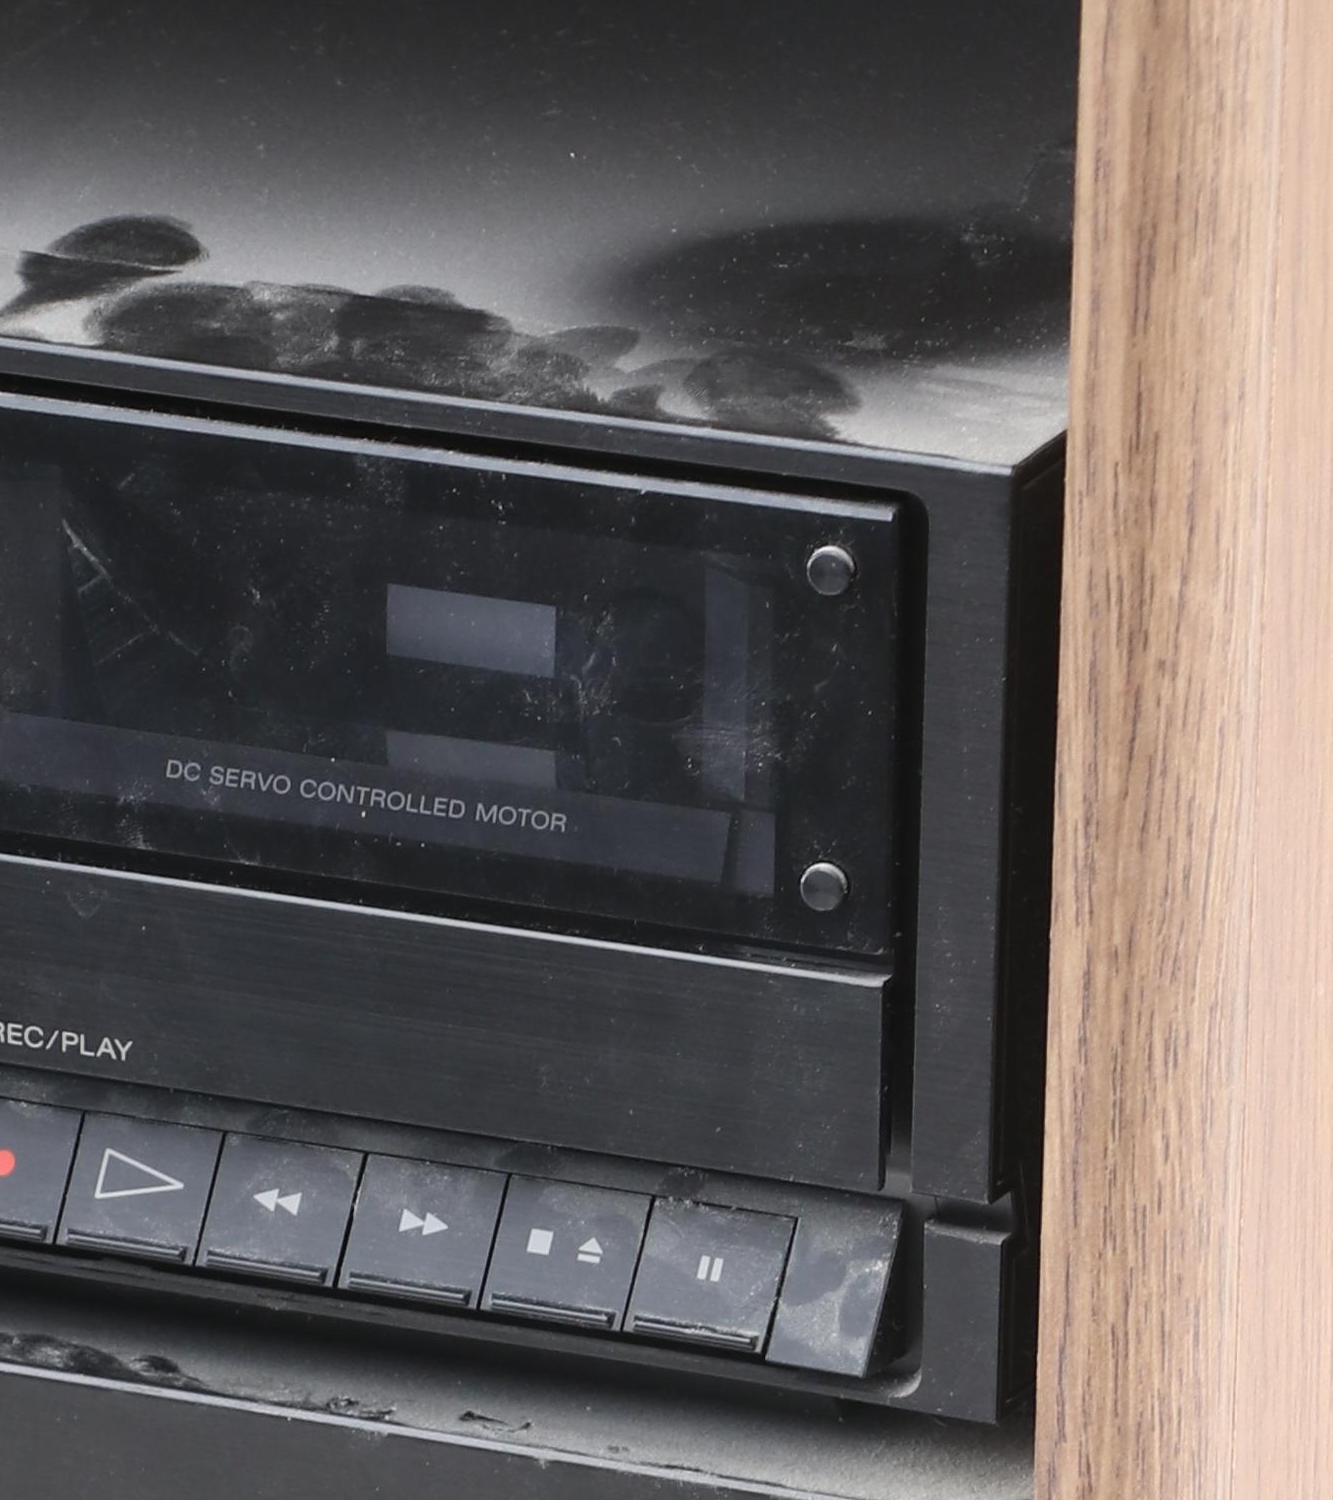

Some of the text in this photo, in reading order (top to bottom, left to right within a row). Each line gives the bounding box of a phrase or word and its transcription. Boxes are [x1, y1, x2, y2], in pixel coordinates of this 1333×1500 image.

[166, 759, 567, 833] DC SERVO CONTROLLED MOTOR
